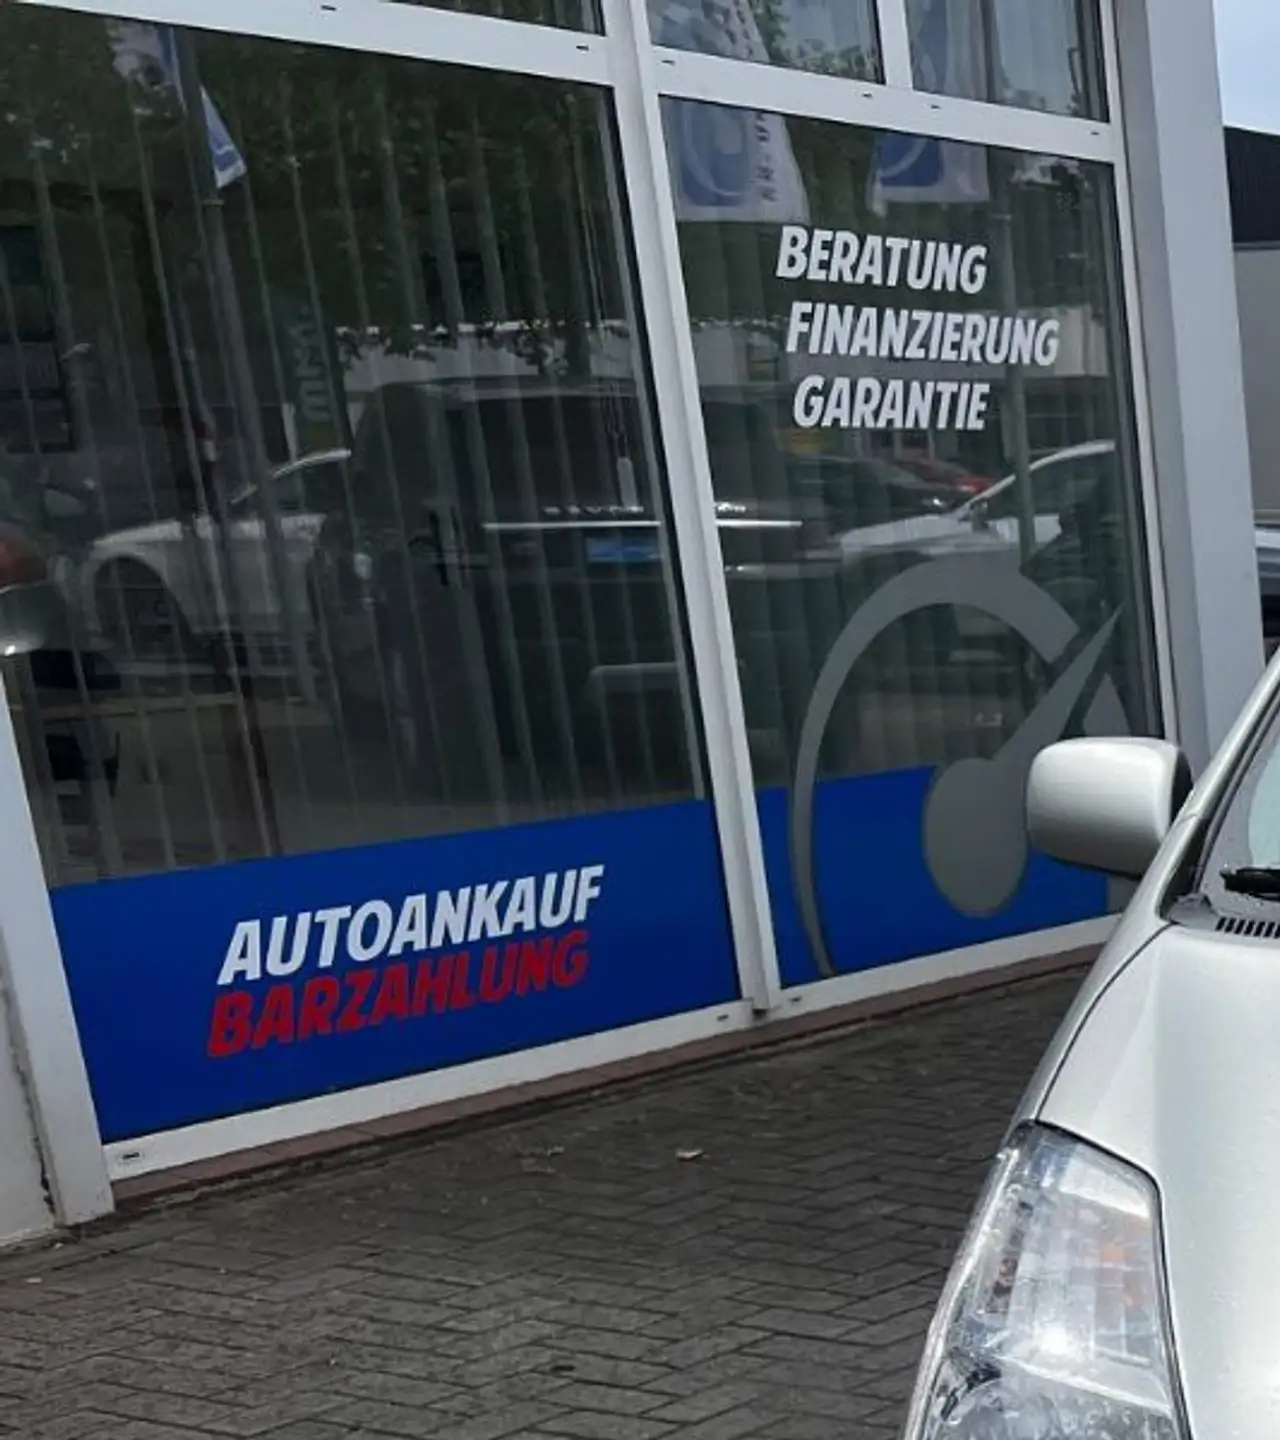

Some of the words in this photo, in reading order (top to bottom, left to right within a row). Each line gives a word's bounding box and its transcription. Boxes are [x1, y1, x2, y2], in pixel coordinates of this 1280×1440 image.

[776, 225, 988, 294] BERATUNG
[786, 301, 1061, 366] FINANZIERUNG
[793, 375, 990, 430] GARANTIE
[216, 864, 604, 985] AUTOANKAUF
[206, 930, 589, 1057] BARZAHLUNG
